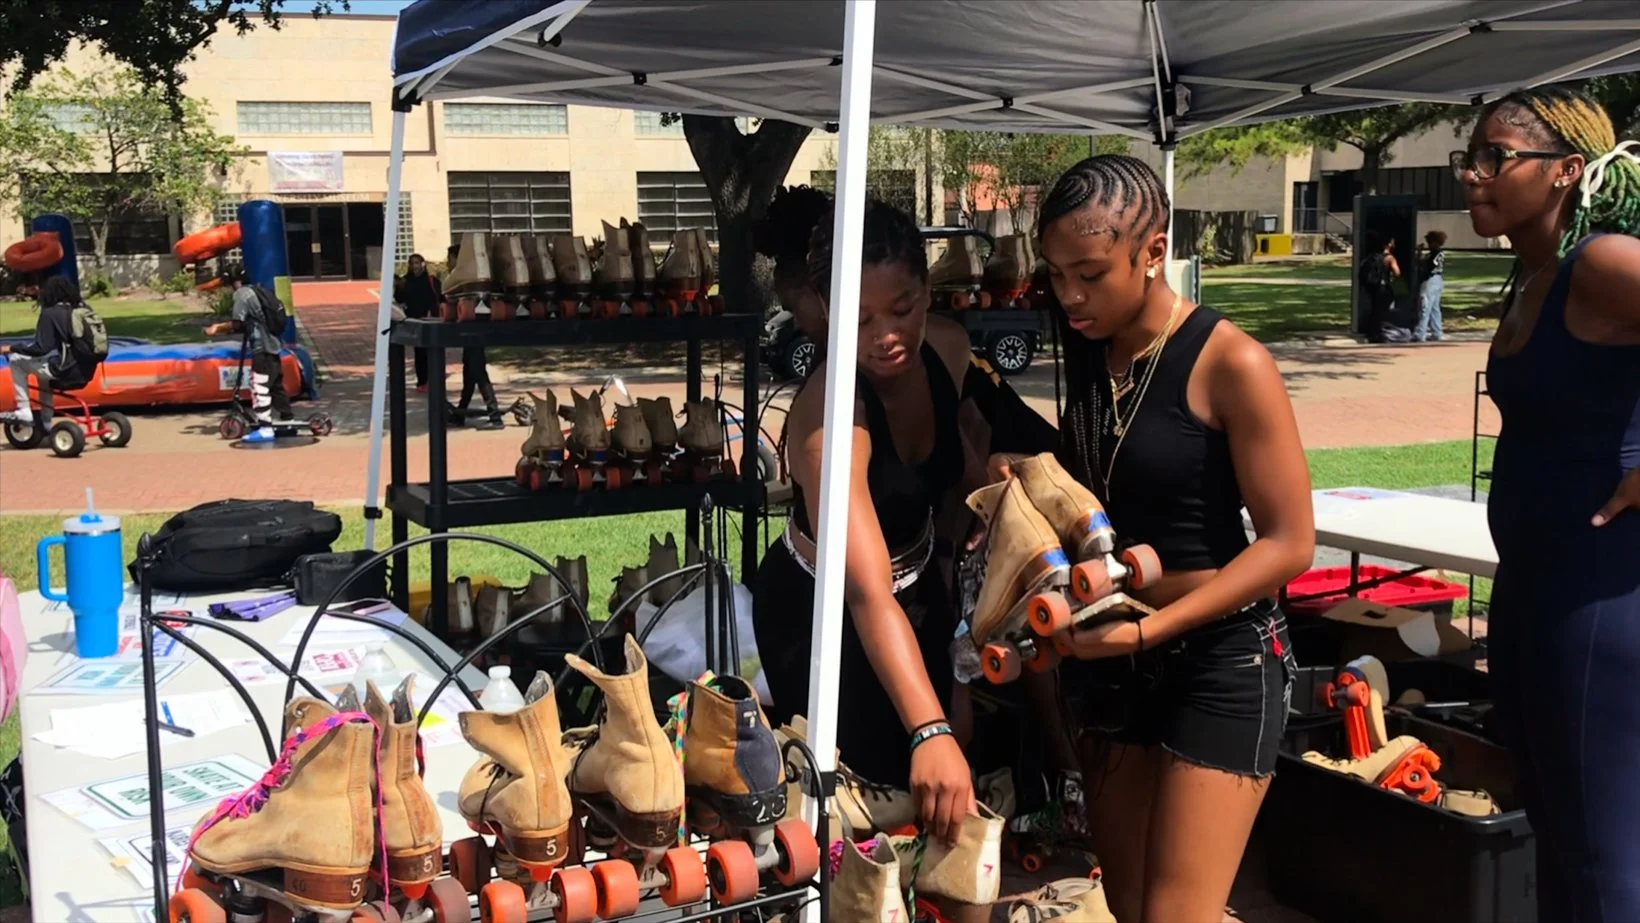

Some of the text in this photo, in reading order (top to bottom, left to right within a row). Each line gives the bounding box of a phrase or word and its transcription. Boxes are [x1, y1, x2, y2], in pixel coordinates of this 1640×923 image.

[742, 710, 758, 729] 7
[656, 826, 668, 842] 5
[546, 838, 557, 856] 5
[423, 855, 433, 873] 5
[982, 863, 994, 877] 7
[351, 878, 362, 897] 5
[887, 907, 899, 923] 7
